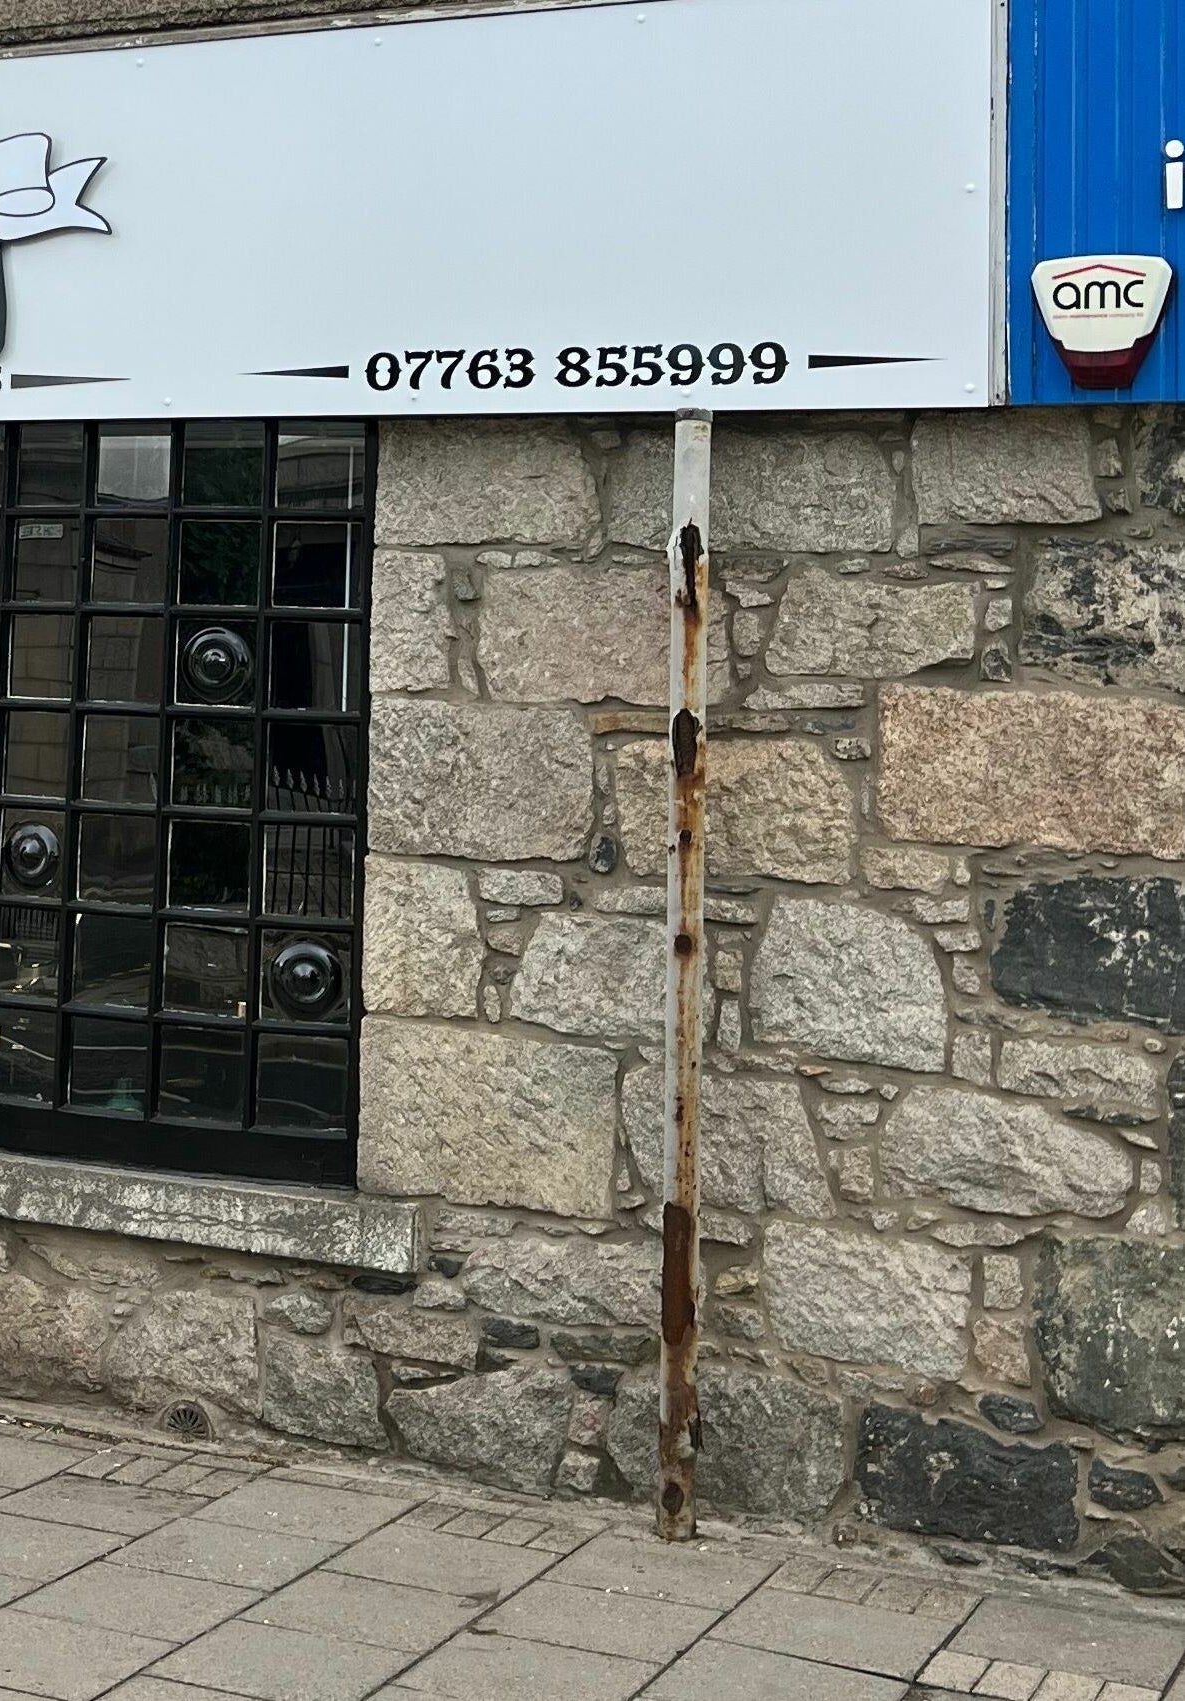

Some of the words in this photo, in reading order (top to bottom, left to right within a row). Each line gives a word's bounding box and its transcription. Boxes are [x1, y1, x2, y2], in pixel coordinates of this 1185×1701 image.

[1053, 279, 1144, 310] amc
[365, 347, 536, 391] 07763
[554, 341, 790, 387] 855999
